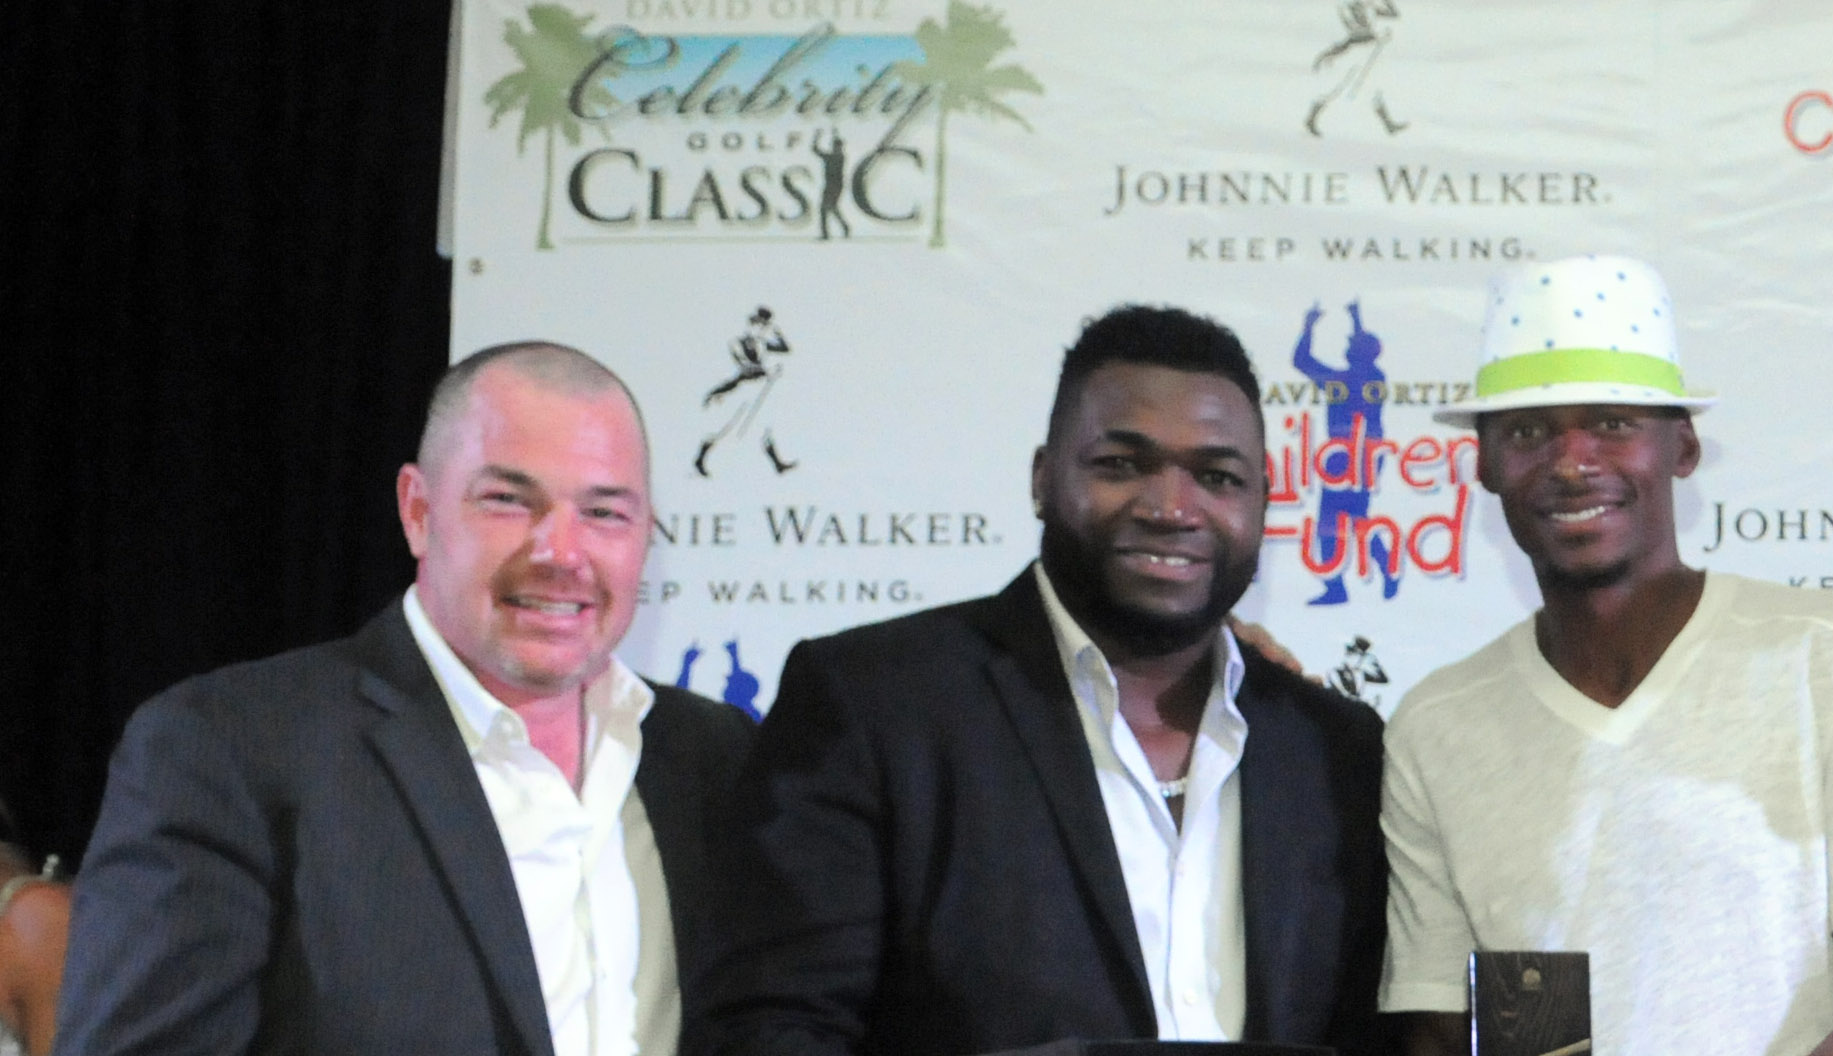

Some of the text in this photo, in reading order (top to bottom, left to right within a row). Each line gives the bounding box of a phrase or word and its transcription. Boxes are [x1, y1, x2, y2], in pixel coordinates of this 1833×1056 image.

[569, 23, 934, 148] Celebrity
[687, 132, 803, 151] GOLF
[1104, 164, 1349, 217] JOHNNIE
[1187, 237, 1295, 262] KEEP
[1262, 379, 1471, 405] AVID ORTIZ
